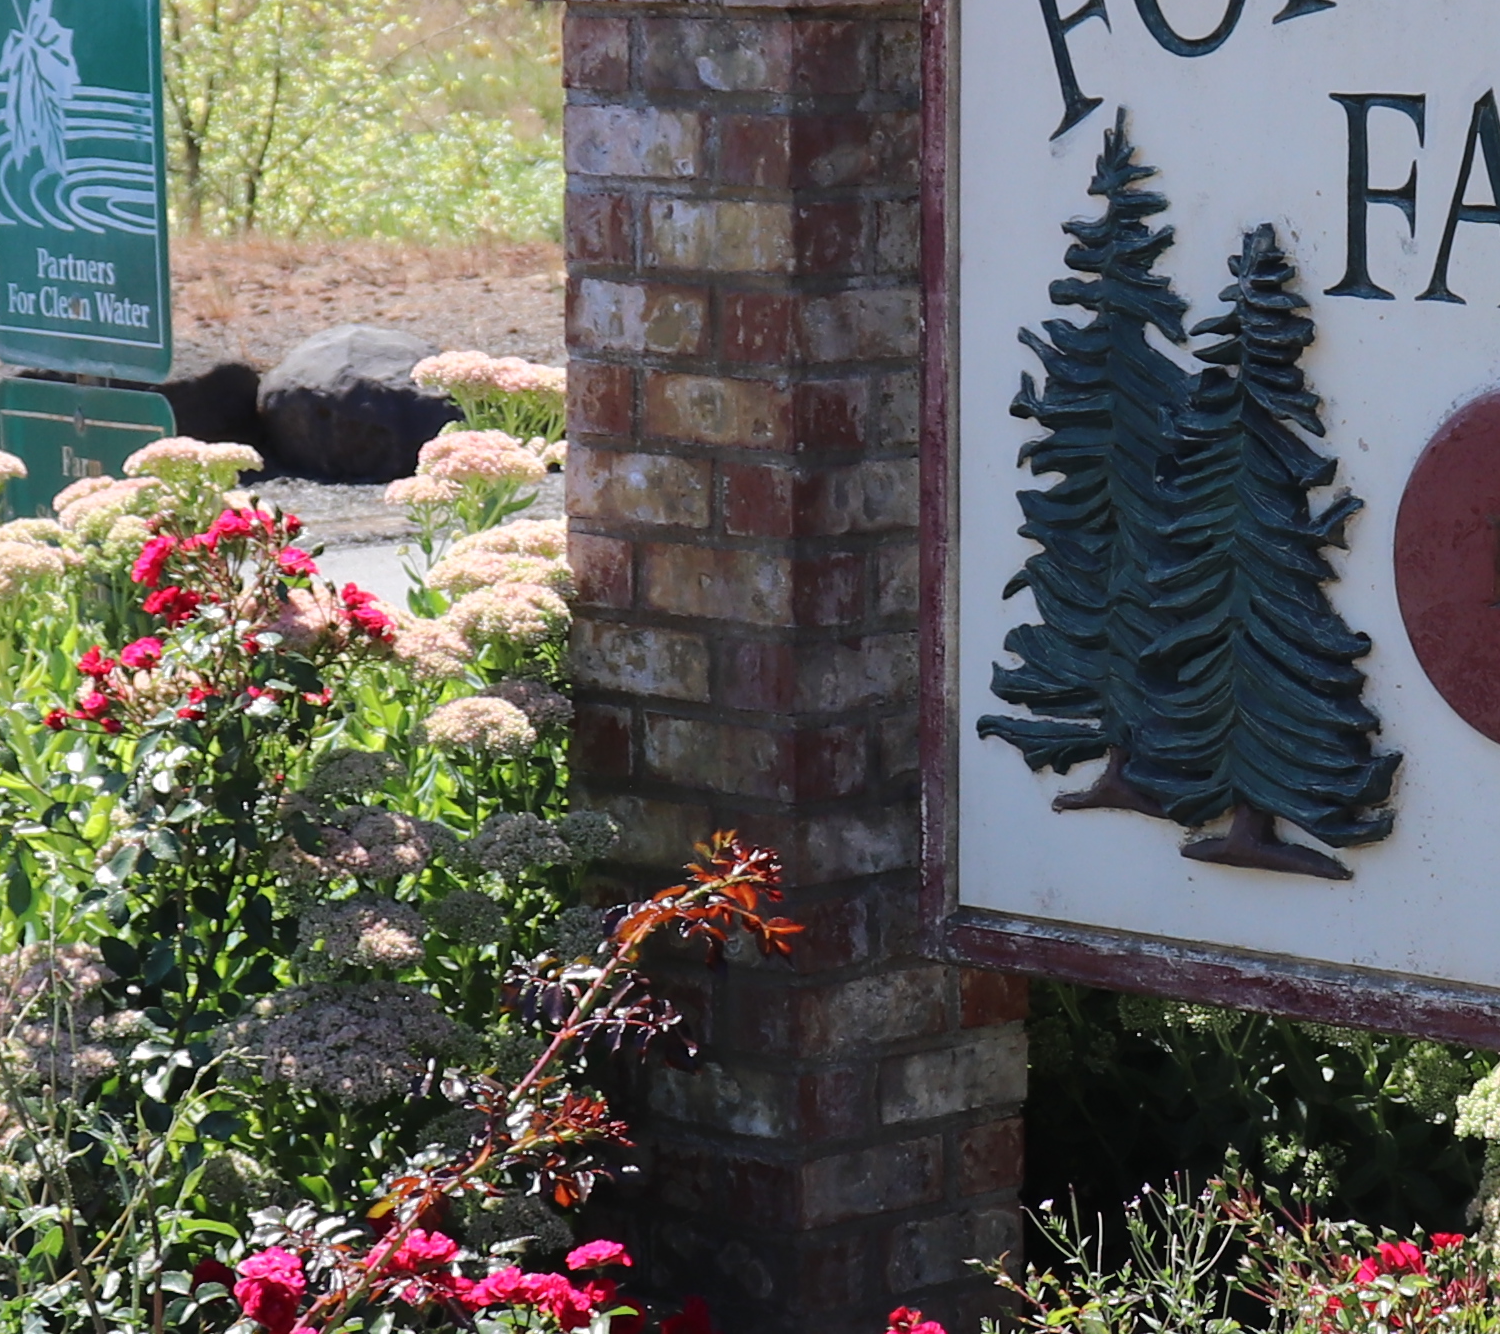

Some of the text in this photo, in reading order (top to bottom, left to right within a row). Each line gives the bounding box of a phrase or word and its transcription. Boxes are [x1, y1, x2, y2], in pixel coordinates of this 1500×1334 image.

[36, 247, 116, 285] Partners
[7, 282, 37, 315] For
[94, 291, 151, 328] Water
